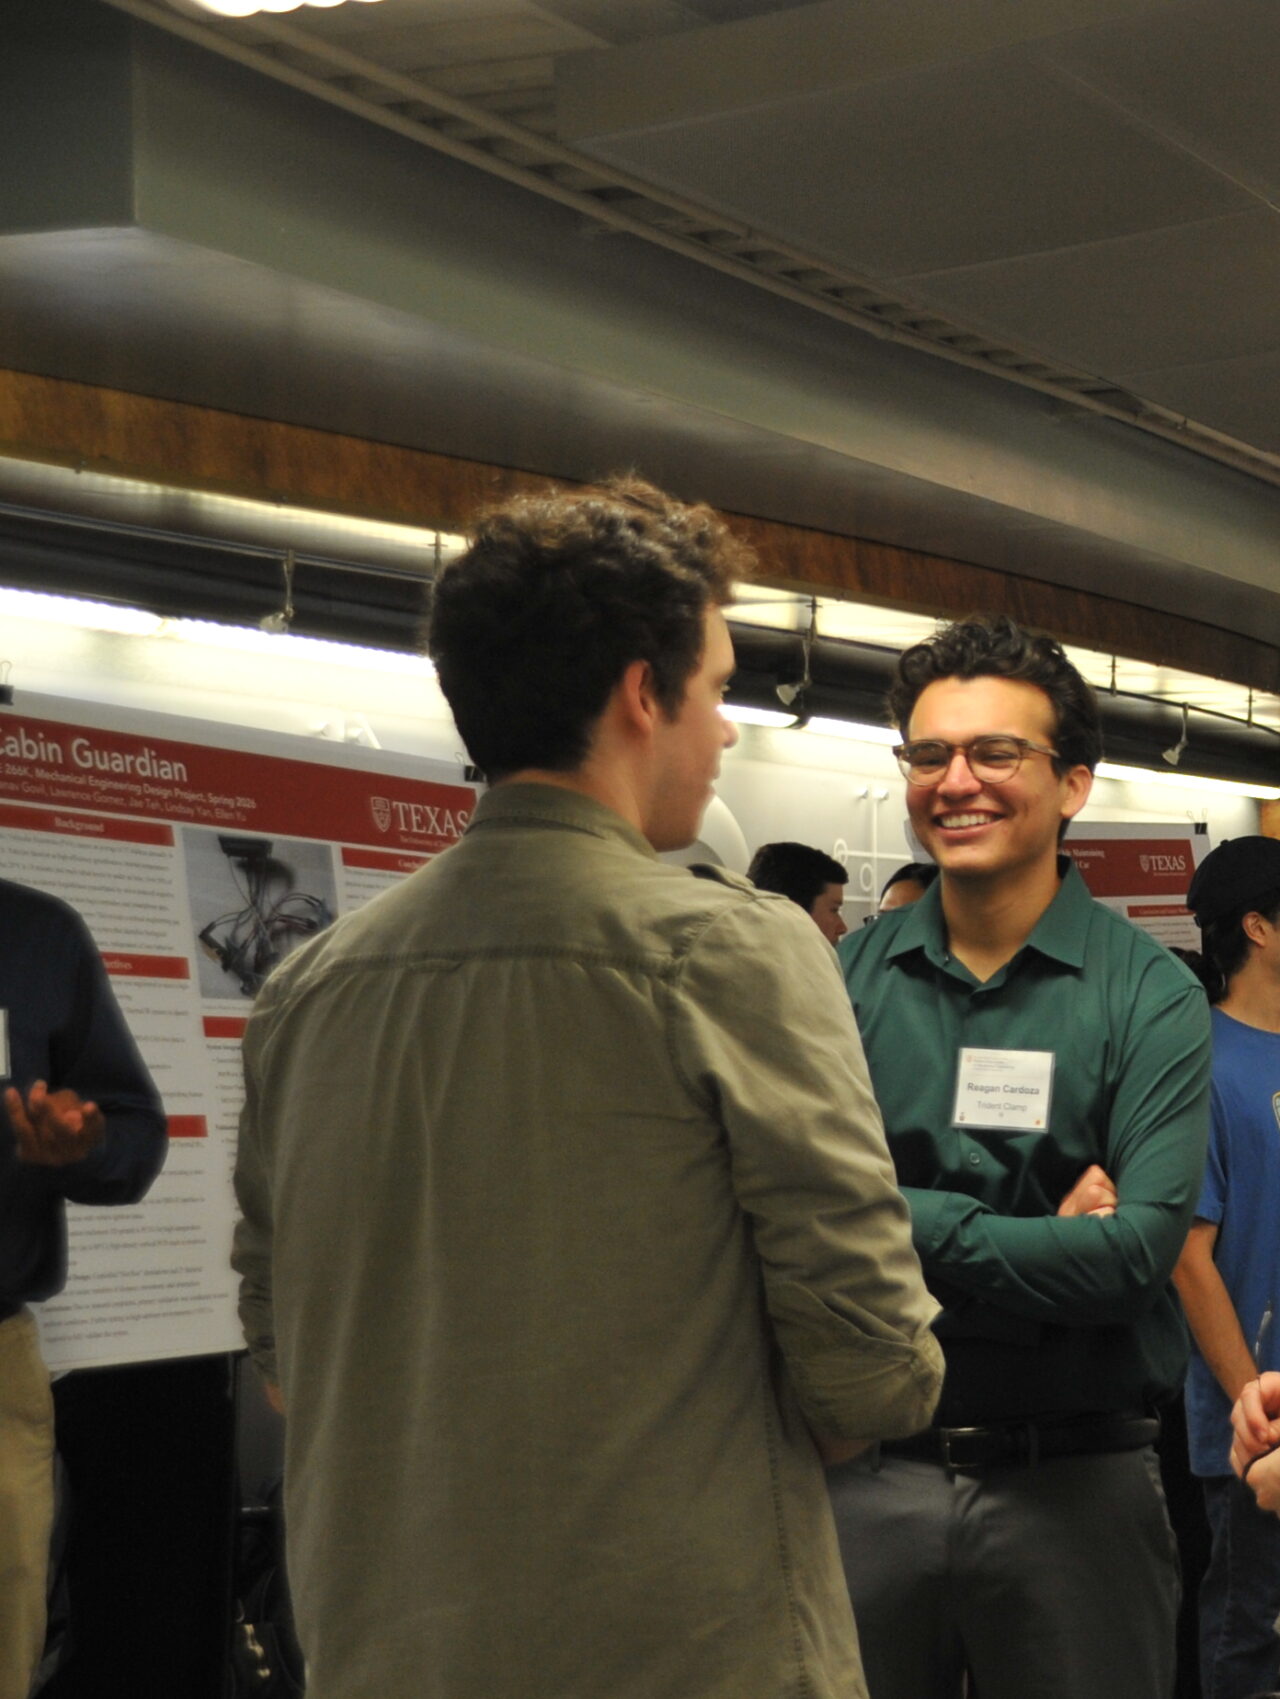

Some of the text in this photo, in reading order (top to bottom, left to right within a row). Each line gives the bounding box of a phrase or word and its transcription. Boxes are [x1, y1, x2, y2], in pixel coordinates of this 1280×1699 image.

[71, 738, 188, 783] Guardian
[35, 767, 87, 785] Mechanical
[88, 775, 142, 796] Engineering
[143, 783, 173, 799] Design
[208, 792, 235, 809] Spring
[54, 815, 105, 833] Background
[392, 801, 470, 838] TEXAS
[1150, 855, 1187, 871] TEXAS
[967, 1082, 1040, 1095] Reagan Cardoza
[977, 1101, 1027, 1112] Trident Clamp
